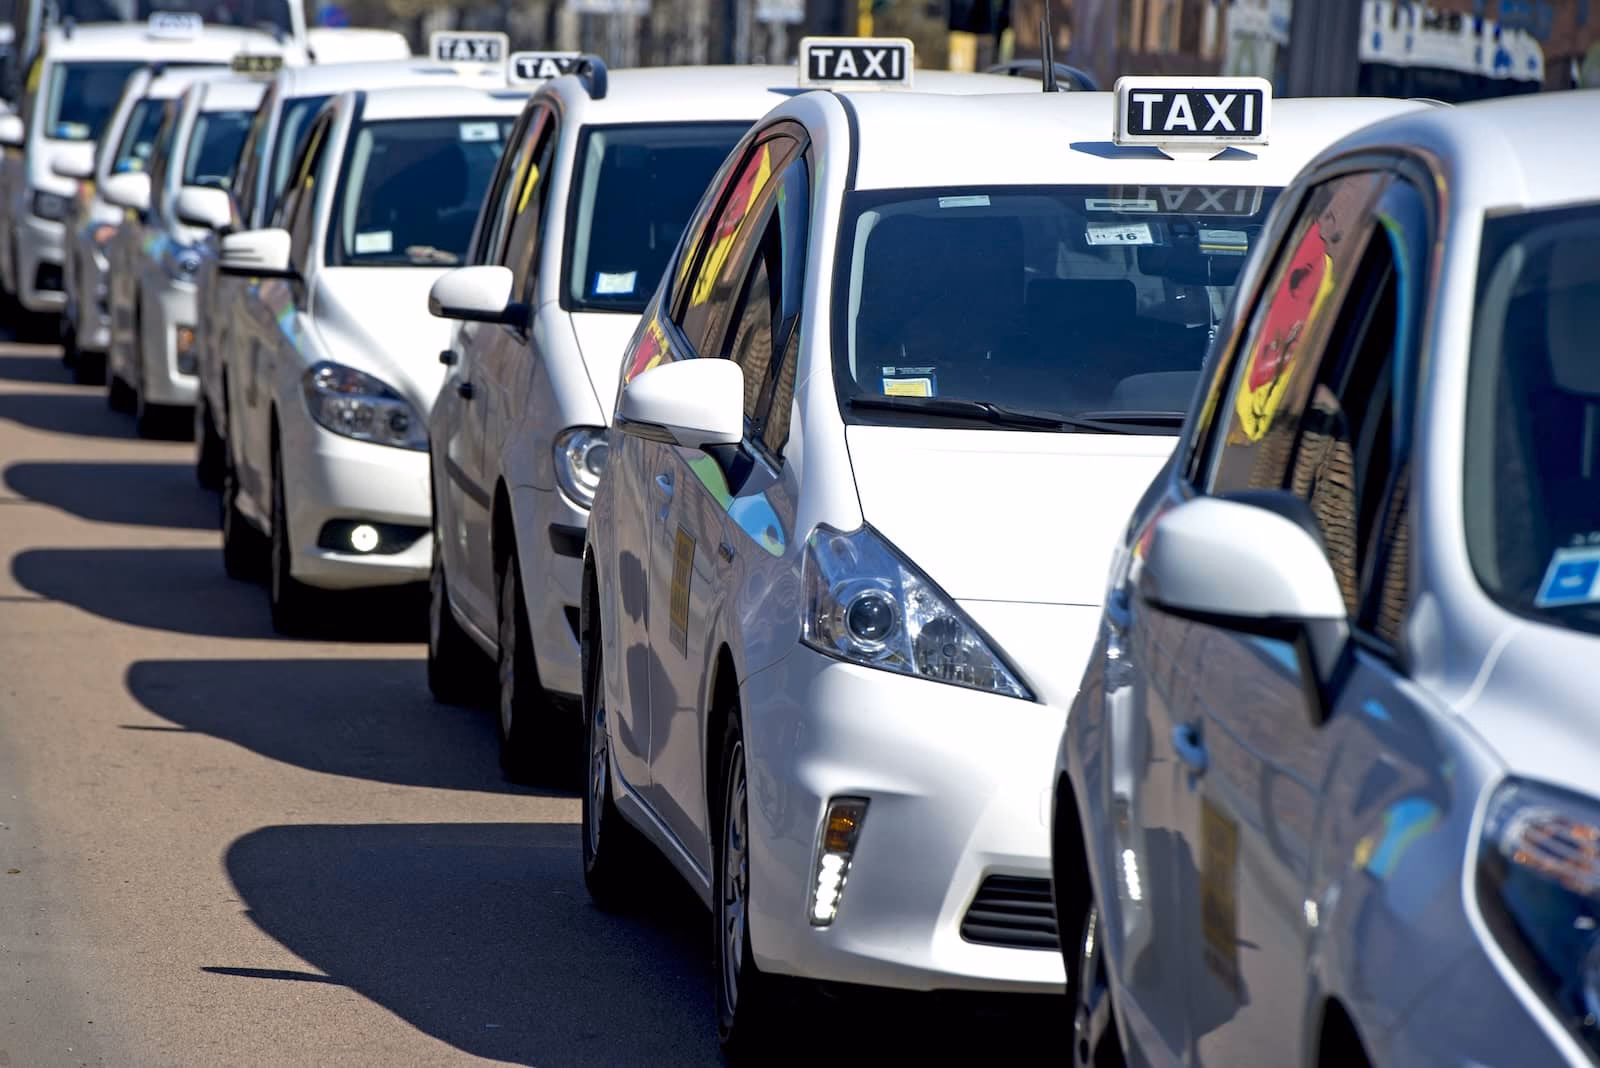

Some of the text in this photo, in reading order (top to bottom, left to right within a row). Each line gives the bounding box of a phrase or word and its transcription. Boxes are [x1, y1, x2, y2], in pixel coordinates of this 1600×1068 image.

[438, 39, 500, 62] TAXI
[517, 57, 571, 79] TA
[809, 48, 900, 78] TAXI
[1132, 93, 1255, 132] TAXI
[1114, 232, 1138, 241] 16
